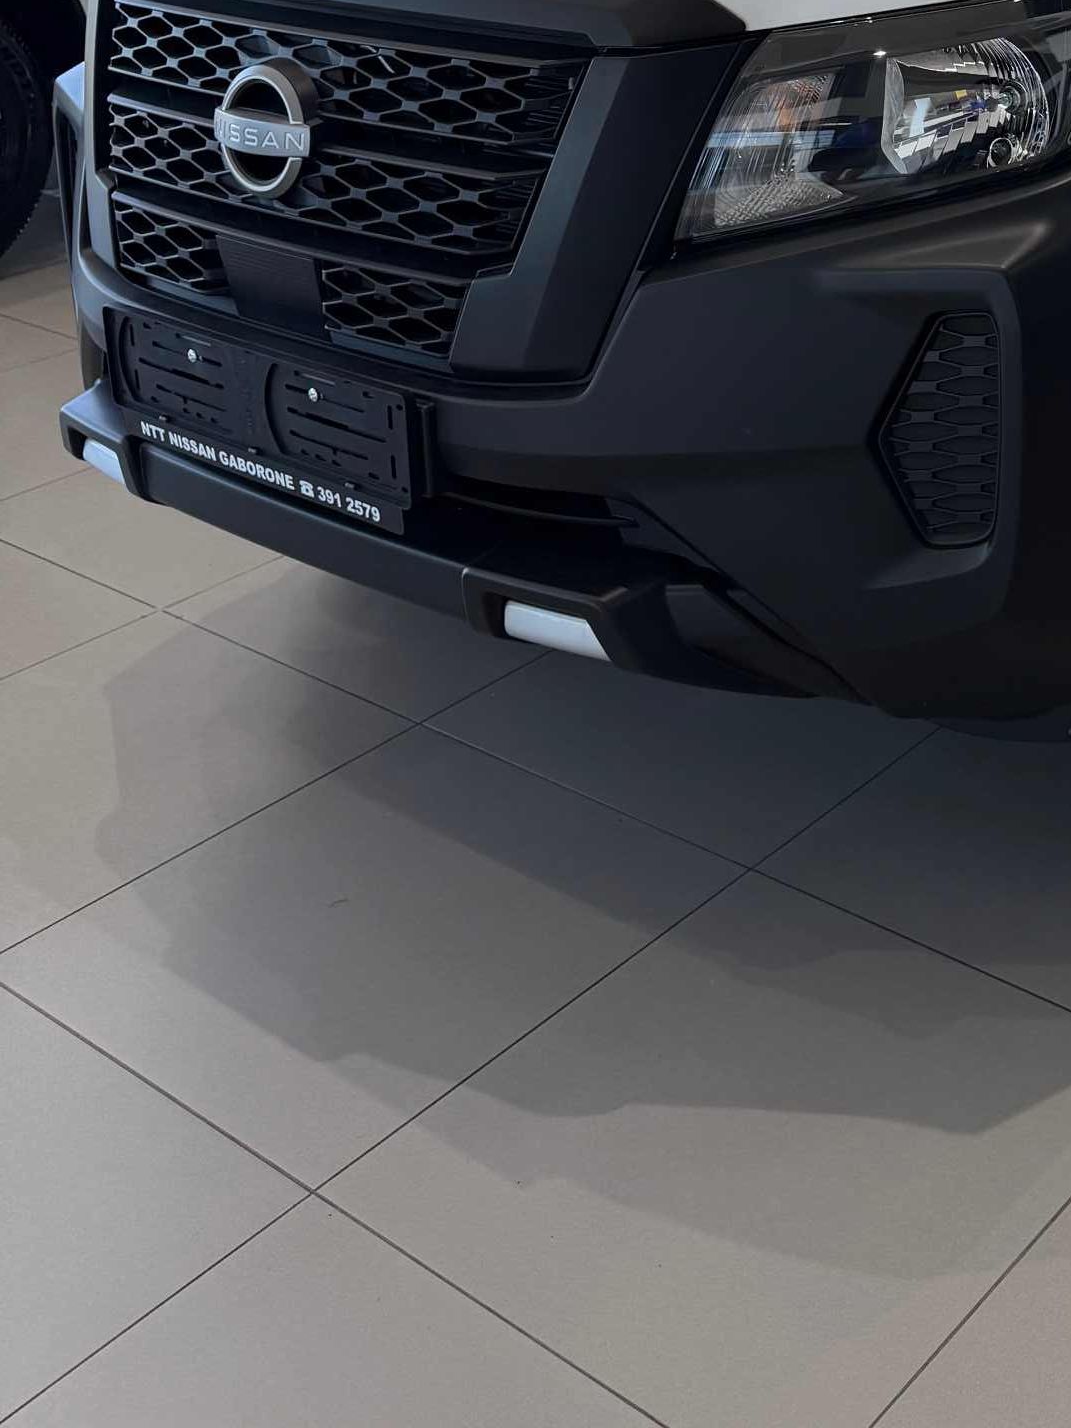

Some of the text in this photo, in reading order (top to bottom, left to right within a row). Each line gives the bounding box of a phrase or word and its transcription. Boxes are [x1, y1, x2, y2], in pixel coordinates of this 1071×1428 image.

[215, 116, 305, 151] NISSAN
[140, 420, 381, 523] NTT NISSAN GABORONE 391 2579
